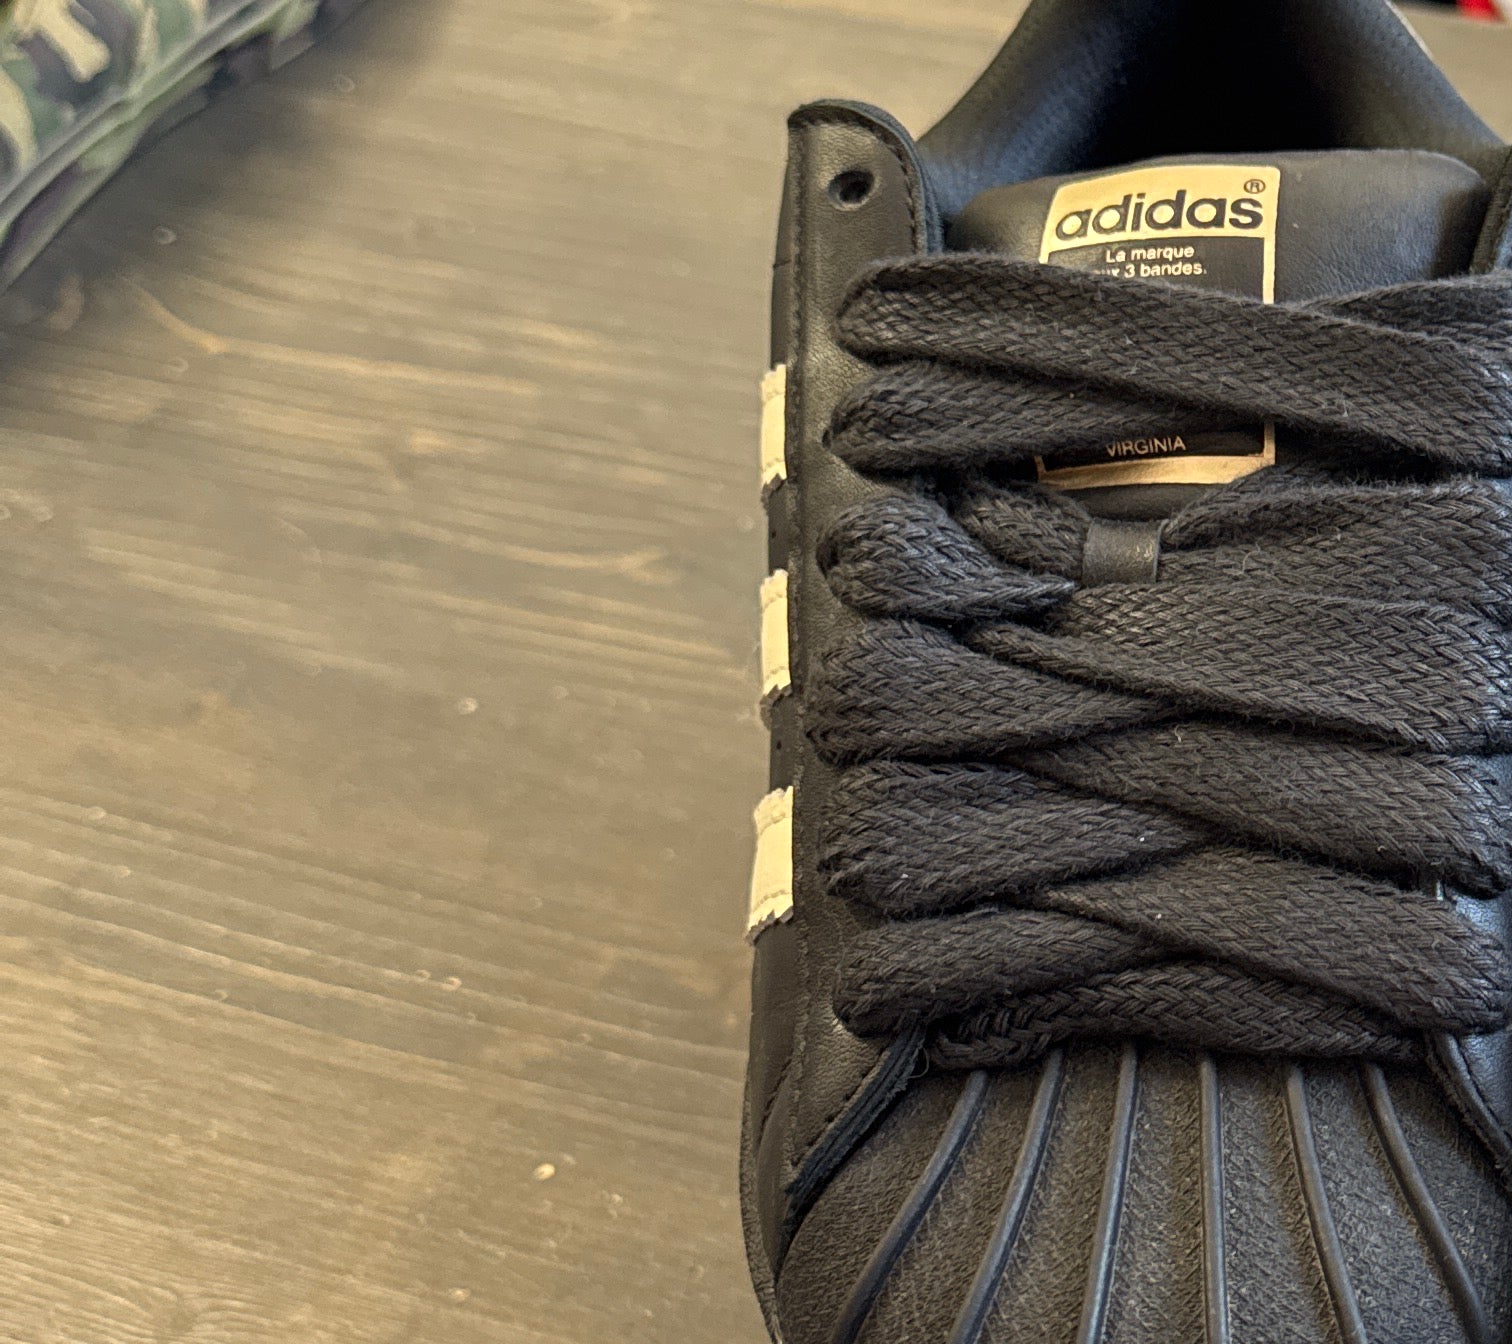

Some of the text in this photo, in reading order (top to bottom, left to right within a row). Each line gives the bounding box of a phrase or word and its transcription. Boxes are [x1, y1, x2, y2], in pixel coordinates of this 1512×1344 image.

[1056, 190, 1264, 241] adidas
[1105, 246, 1195, 264] La marque
[1124, 263, 1136, 278] 3
[1140, 261, 1207, 277] bandes.
[1106, 435, 1187, 457] VIRGINIA
